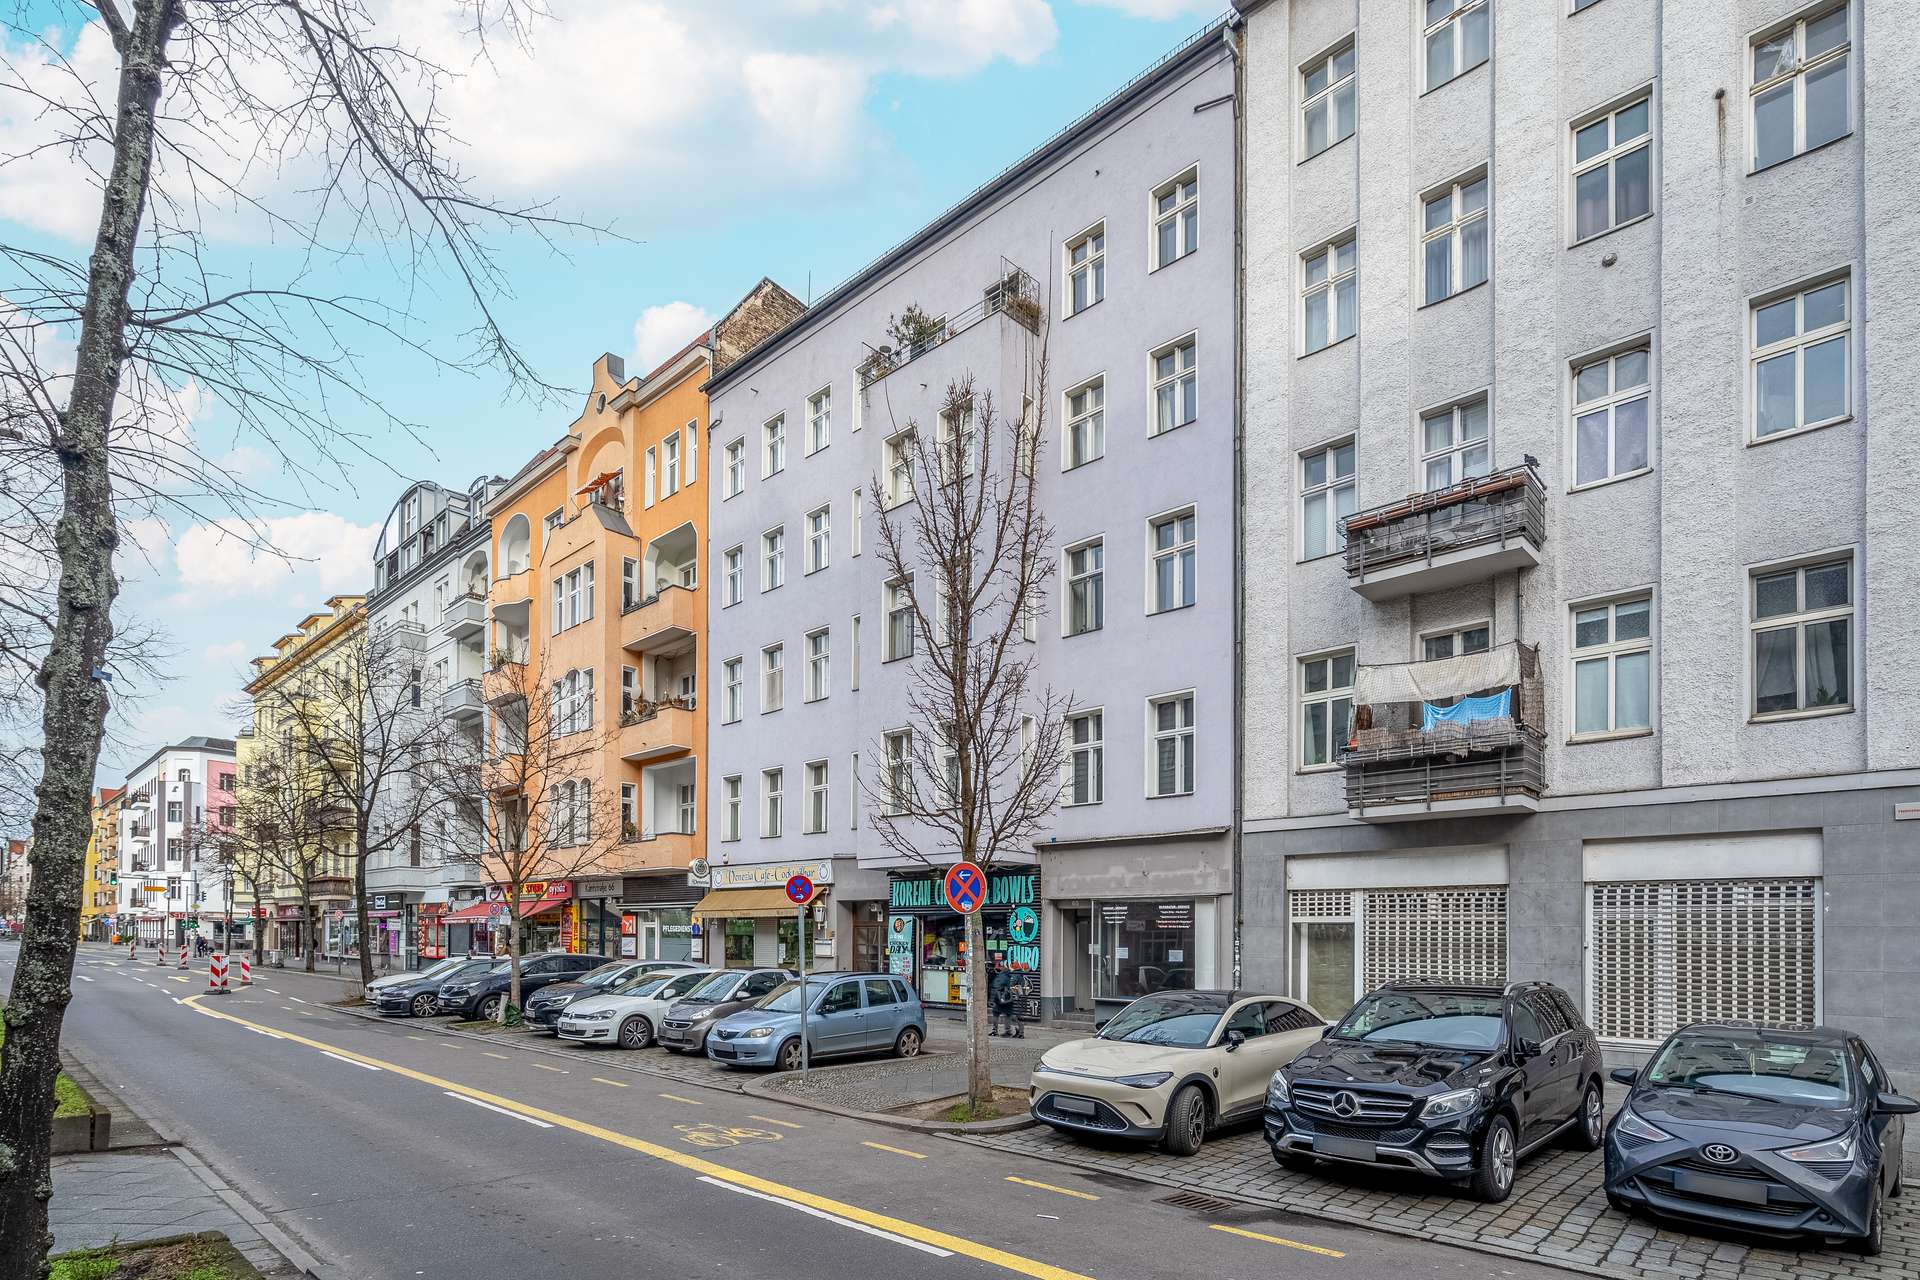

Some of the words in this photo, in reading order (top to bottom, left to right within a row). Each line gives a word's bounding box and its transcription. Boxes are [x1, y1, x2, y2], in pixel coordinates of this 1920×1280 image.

[892, 880, 931, 906] KOREAN
[992, 875, 1035, 904] BOWLS
[890, 945, 908, 954] DAY
[1007, 945, 1039, 971] CHIRO
